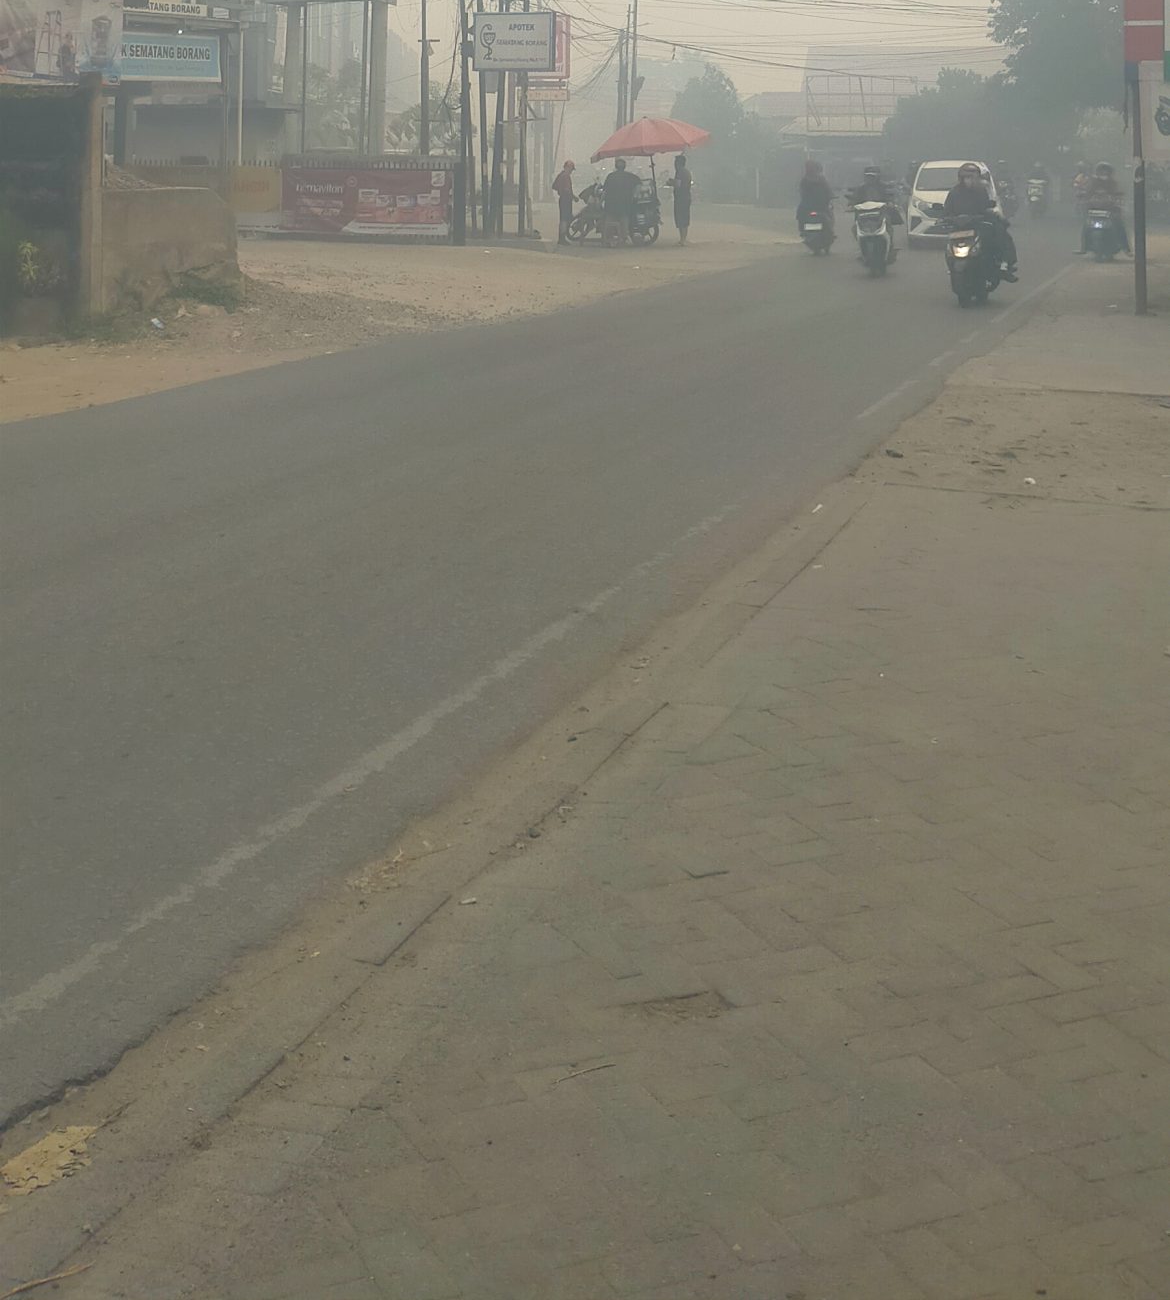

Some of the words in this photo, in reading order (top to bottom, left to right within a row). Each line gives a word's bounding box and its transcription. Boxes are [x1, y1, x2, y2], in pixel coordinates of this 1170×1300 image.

[171, 4, 200, 14] BORANG
[129, 44, 174, 58] SEMATANG
[177, 46, 210, 60] BORANG
